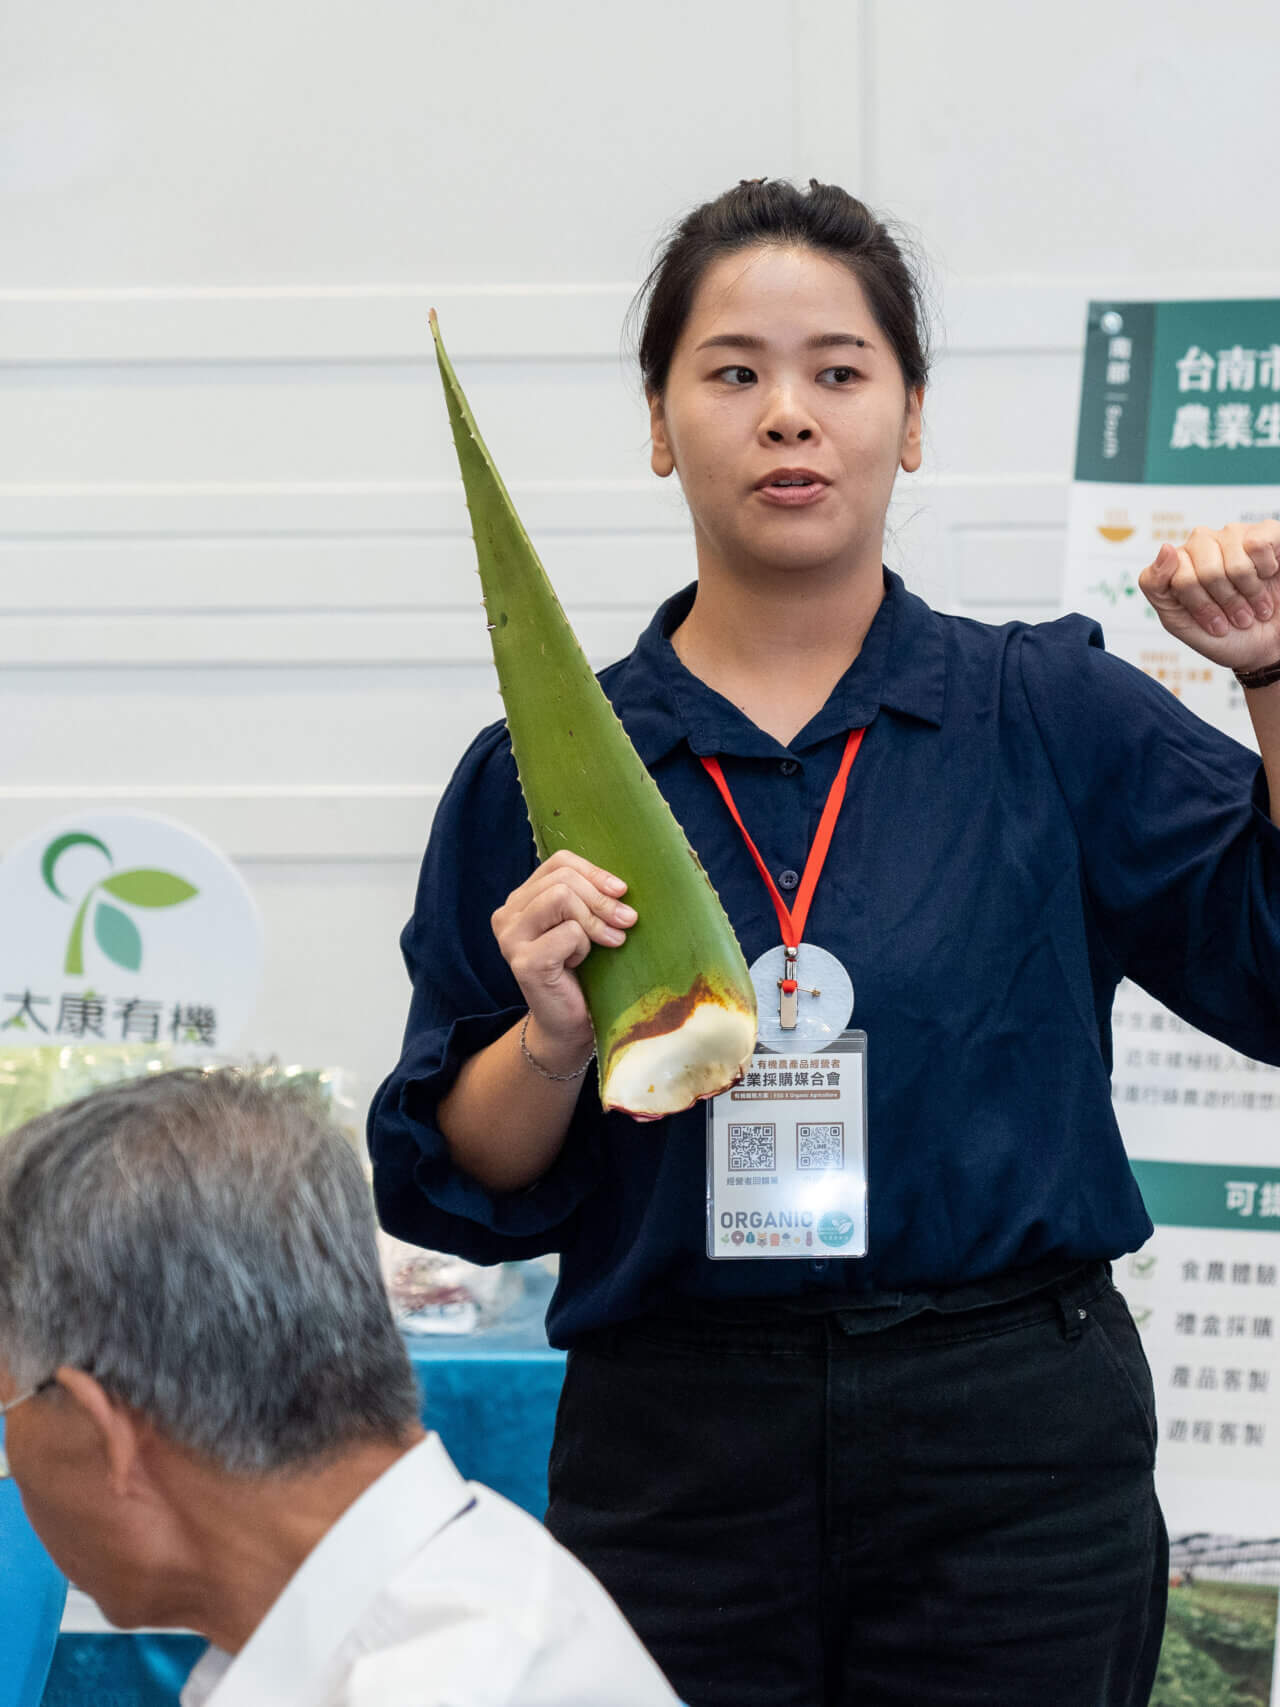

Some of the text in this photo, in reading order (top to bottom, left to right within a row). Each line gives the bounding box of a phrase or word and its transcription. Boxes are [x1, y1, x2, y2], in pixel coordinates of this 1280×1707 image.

[1, 986, 216, 1047] 太康有機
[720, 1211, 813, 1228] ORGANIC
[1175, 1312, 1274, 1339] 禮盒採購
[1170, 1366, 1270, 1393] 產品客製
